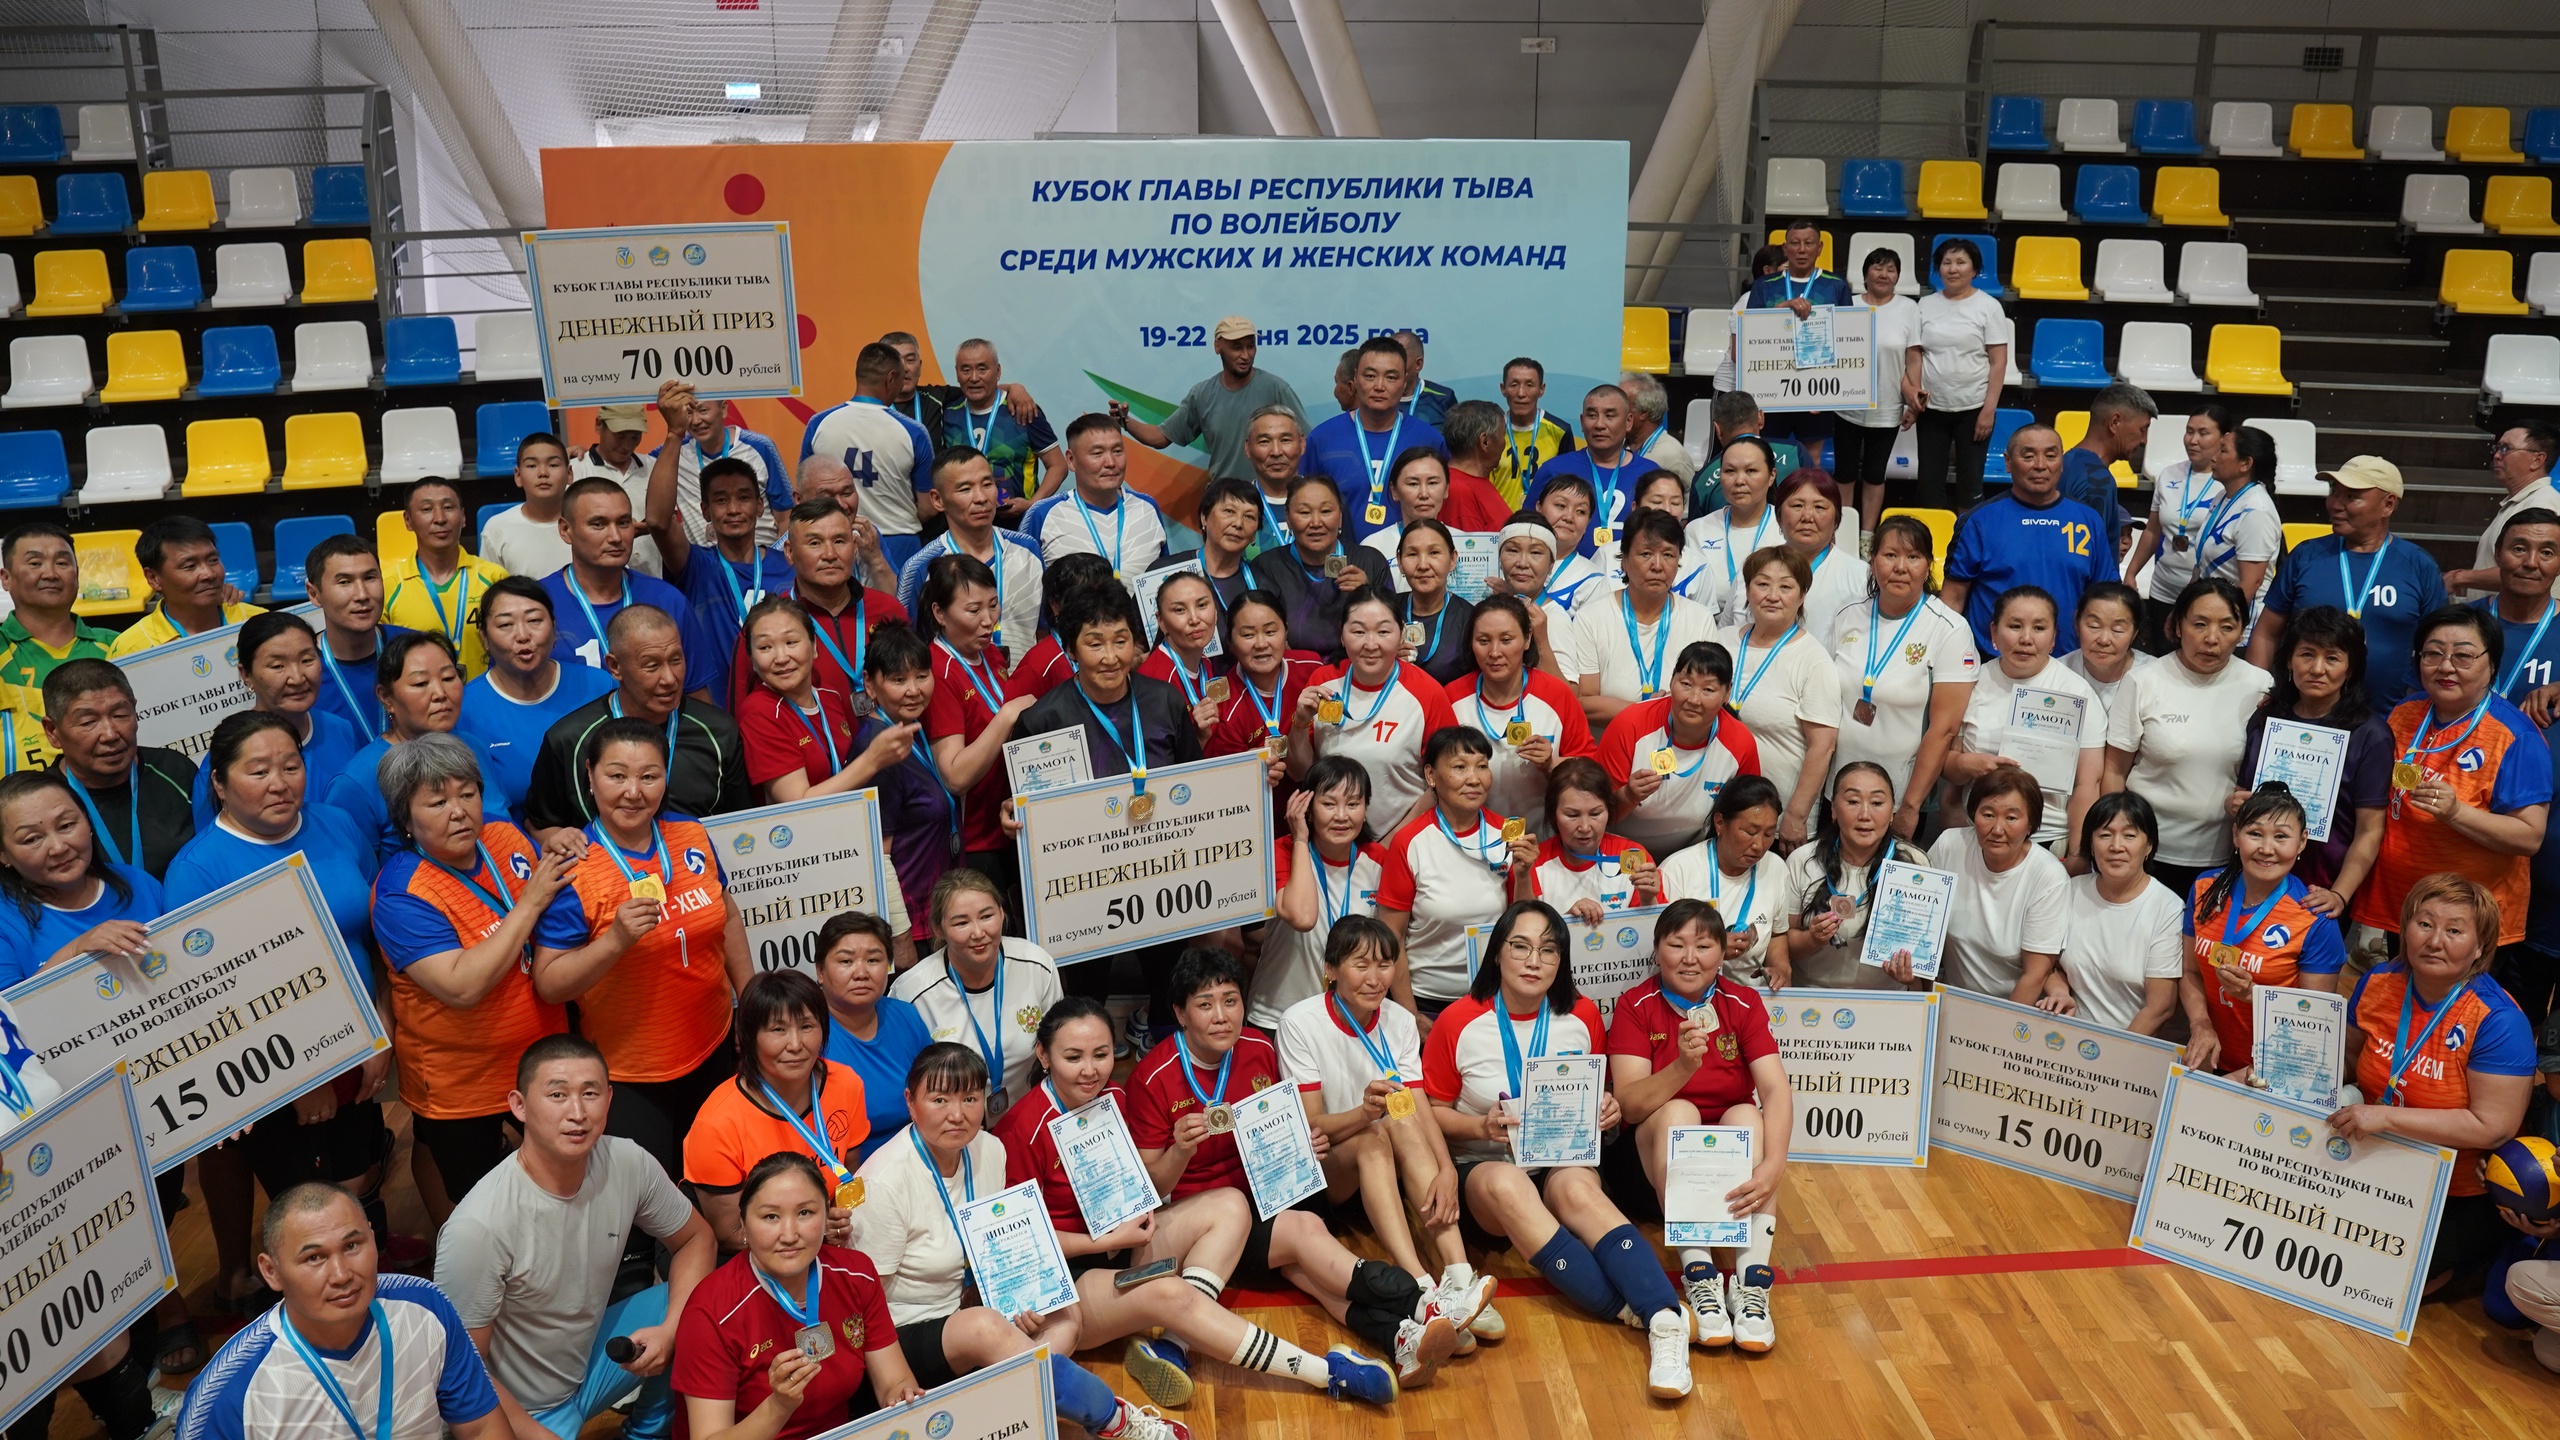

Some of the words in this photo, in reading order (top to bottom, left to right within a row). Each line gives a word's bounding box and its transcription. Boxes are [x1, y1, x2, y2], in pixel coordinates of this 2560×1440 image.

[1032, 180, 1133, 202] КУБОК
[1139, 179, 1241, 201] ГЛАВЫ
[1249, 177, 1444, 200] РЕСПУБЛИКИ
[1453, 177, 1534, 199] ТЫВА
[1170, 213, 1213, 235] ПО
[1220, 207, 1401, 234] ВОЛЕЙБОЛУ
[1000, 249, 1097, 274] СРЕДИ
[1106, 247, 1255, 270] МУЖСКИХ
[1262, 247, 1283, 268] И
[1289, 245, 1434, 268] ЖЕНСКИХ
[1441, 245, 1567, 270] КОМАНД
[553, 282, 597, 294] КУБОК
[600, 280, 643, 291] ГЛАВЫ
[647, 276, 732, 288] РЕСПУБЛИКИ
[735, 275, 770, 285] ТЫВА
[614, 293, 633, 303] ПО
[636, 289, 713, 301] ВОЛЕЙБОЛУ
[558, 309, 708, 342] ДЕНЕЖНЫЙ
[712, 311, 776, 331] ПРИЗ
[1140, 325, 1207, 347] 19-22
[1297, 324, 1359, 345] 2025
[563, 375, 578, 384] на
[581, 372, 621, 384] сумму
[622, 347, 663, 380] 70
[673, 344, 734, 377] 000
[739, 363, 781, 377] рублей
[1780, 378, 1801, 397] 70
[1808, 377, 1841, 397] 000
[1842, 388, 1866, 397] рублей
[844, 447, 879, 488] 4
[1506, 446, 1540, 479] 13
[1602, 488, 1626, 530] 2
[2021, 518, 2060, 527] GIVOVA
[2061, 521, 2091, 557] 12
[2368, 585, 2397, 607] 10
[2524, 658, 2552, 685] 11
[181, 684, 225, 706] ГЛАВЫ
[198, 702, 218, 716] ПО
[1372, 720, 1399, 743] 17
[2021, 711, 2071, 726] ГРАМОТА
[1021, 755, 1076, 774] ГРАМОТА
[2274, 747, 2330, 765] ГРАМОТА
[1042, 836, 1085, 854] КУБОК
[1087, 827, 1130, 844] ГЛАВЫ
[1132, 811, 1215, 835] РЕСПУБЛИКИ
[1217, 803, 1251, 818] ТЫВА
[1101, 841, 1121, 854] ПО
[1122, 827, 1197, 850] ВОЛЕЙБОЛУ
[730, 856, 821, 881] РЕСПУБЛИКИ
[822, 848, 860, 865] ТЫВА
[1044, 848, 1189, 902] ДЕНЕЖНЫЙ
[1194, 838, 1255, 867] ПРИЗ
[728, 872, 801, 896] ОЛЕЙБОЛУ
[1888, 887, 1939, 905] ГРАМОТА
[799, 885, 865, 917] ПРИЗ
[1048, 933, 1063, 944] на
[1065, 924, 1104, 941] сумму
[1106, 894, 1144, 930] 50
[1155, 879, 1213, 919] 000
[1217, 889, 1258, 909] рублей
[674, 927, 689, 969] 1
[36, 1034, 86, 1065] УБОК
[87, 1003, 146, 1043] ГЛАВЫ
[149, 948, 258, 1013] РЕСПУБЛИКИ
[259, 926, 305, 962] ТЫВА
[246, 965, 330, 1024] ПРИЗ
[112, 1025, 139, 1048] ПО
[142, 974, 240, 1033] ВОЛЕЙБОЛУ
[2274, 1016, 2331, 1034] ГРАМОТА
[1781, 1049, 1855, 1062] ВОЛЕЙБОЛУ
[1793, 1038, 1875, 1051] РЕСПУБЛИКИ
[1878, 1042, 1912, 1052] ТЫВА
[149, 1078, 209, 1136] 15
[215, 1033, 296, 1098] 000
[303, 1022, 356, 1062] рублей
[1949, 1035, 1990, 1054] КУБОК
[1992, 1047, 2033, 1065] ГЛАВЫ
[2036, 1058, 2120, 1088] РЕСПУБЛИКИ
[2122, 1081, 2159, 1099] ТЫВА
[2003, 1061, 2021, 1073] ПО
[2023, 1065, 2099, 1094] ВОЛЕЙБОЛУ
[1534, 1083, 1589, 1093] ГРАМОТА
[1850, 1076, 1911, 1097] ПРИЗ
[1178, 1097, 1196, 1109] asics
[1942, 1067, 2084, 1122] ДЕНЕЖНЫЙ
[2089, 1107, 2154, 1141] ПРИЗ
[1246, 1112, 1293, 1140] ГРАМОТА
[1805, 1106, 1864, 1139] 000
[1867, 1131, 1909, 1143] рублей
[1068, 1129, 1115, 1156] ГРАМОТА
[1937, 1116, 1951, 1128] на
[1953, 1121, 1991, 1140] сумму
[1995, 1114, 2034, 1149] 15
[2043, 1127, 2102, 1169] 000
[86, 1143, 123, 1175] ТЫВА
[2180, 1124, 2226, 1147] КУБОК
[2227, 1140, 2275, 1163] ГЛАВЫ
[2276, 1155, 2372, 1194] РЕСПУБЛИКИ
[2374, 1185, 2415, 1209] ТЫВА
[2237, 1157, 2258, 1172] ПО
[2260, 1163, 2346, 1200] ВОЛЕЙБОЛУ
[71, 1189, 137, 1256] ПРИЗ
[2166, 1162, 2328, 1232] ДЕНЕЖНЫЙ
[2333, 1216, 2407, 1258] ПРИЗ
[983, 1217, 1031, 1243] ДИПЛОМ
[2155, 1218, 2170, 1231] на
[2173, 1226, 2215, 1248] сумму
[2222, 1217, 2265, 1260] 70
[2275, 1237, 2343, 1288] 000
[2343, 1284, 2395, 1310] рублей
[40, 1269, 105, 1347] 000
[110, 1257, 153, 1303] рублей
[987, 1419, 1030, 1440] ТЫВА
